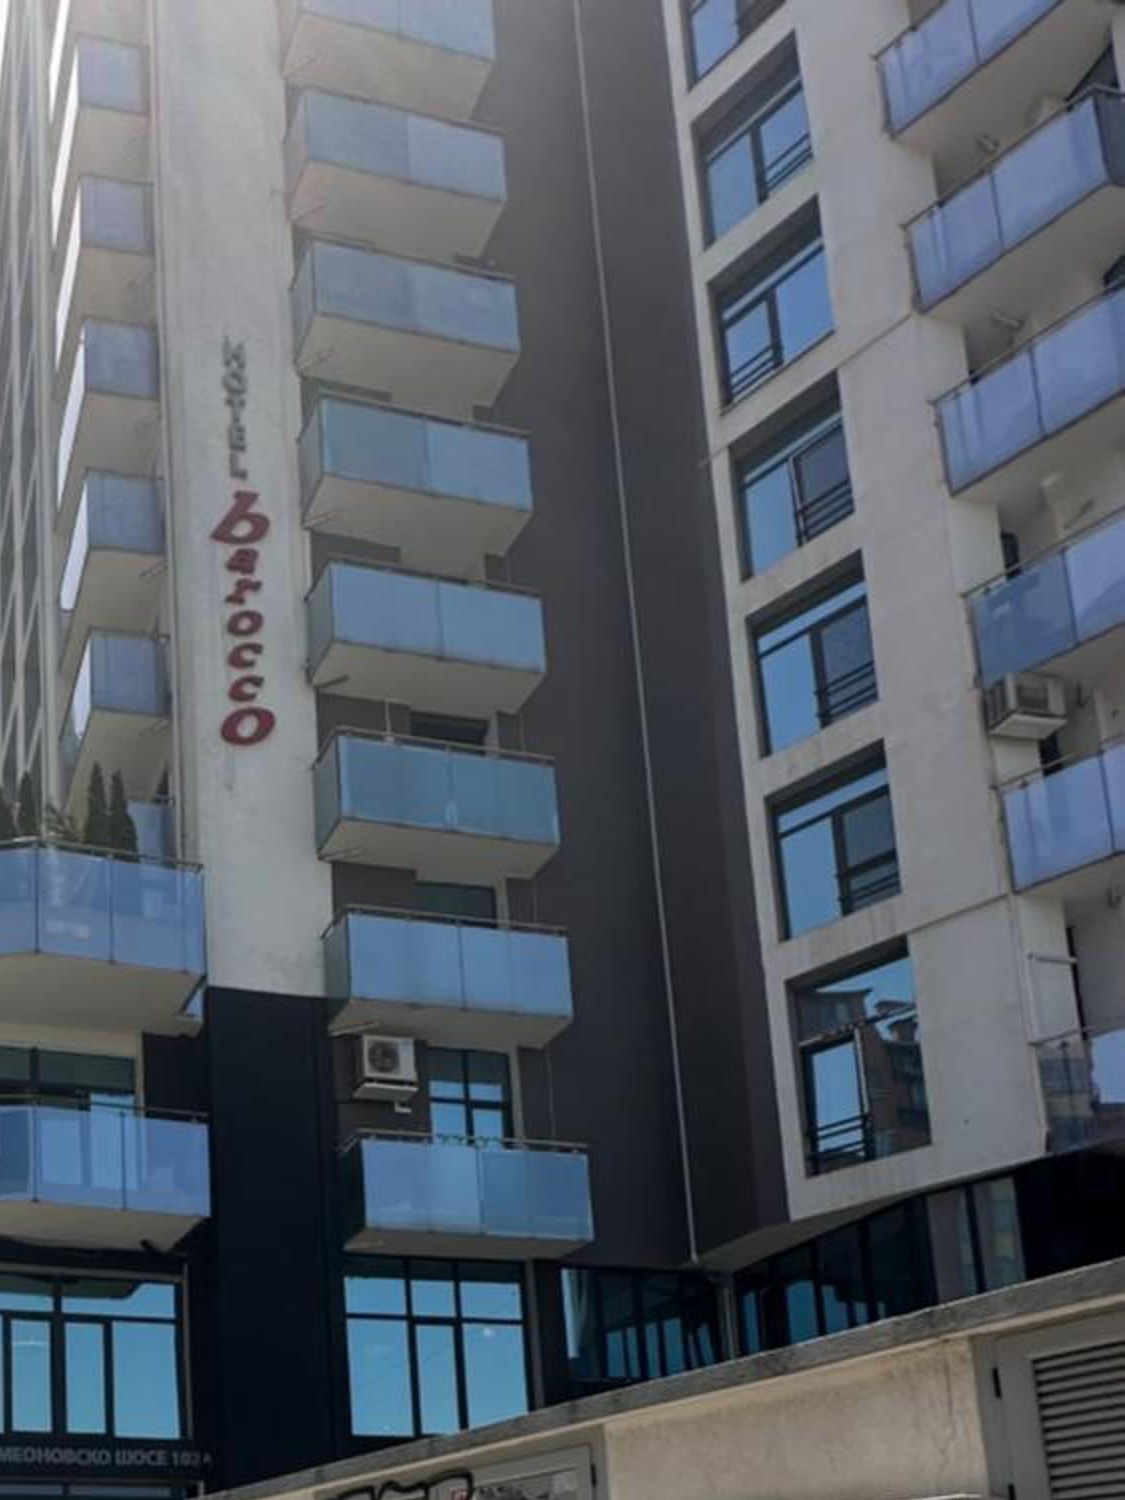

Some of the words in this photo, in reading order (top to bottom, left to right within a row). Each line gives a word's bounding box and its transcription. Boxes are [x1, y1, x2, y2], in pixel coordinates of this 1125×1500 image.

[221, 335, 248, 481] HOTEL
[210, 489, 276, 746] barocco
[114, 1448, 167, 1467] ШОСЕ
